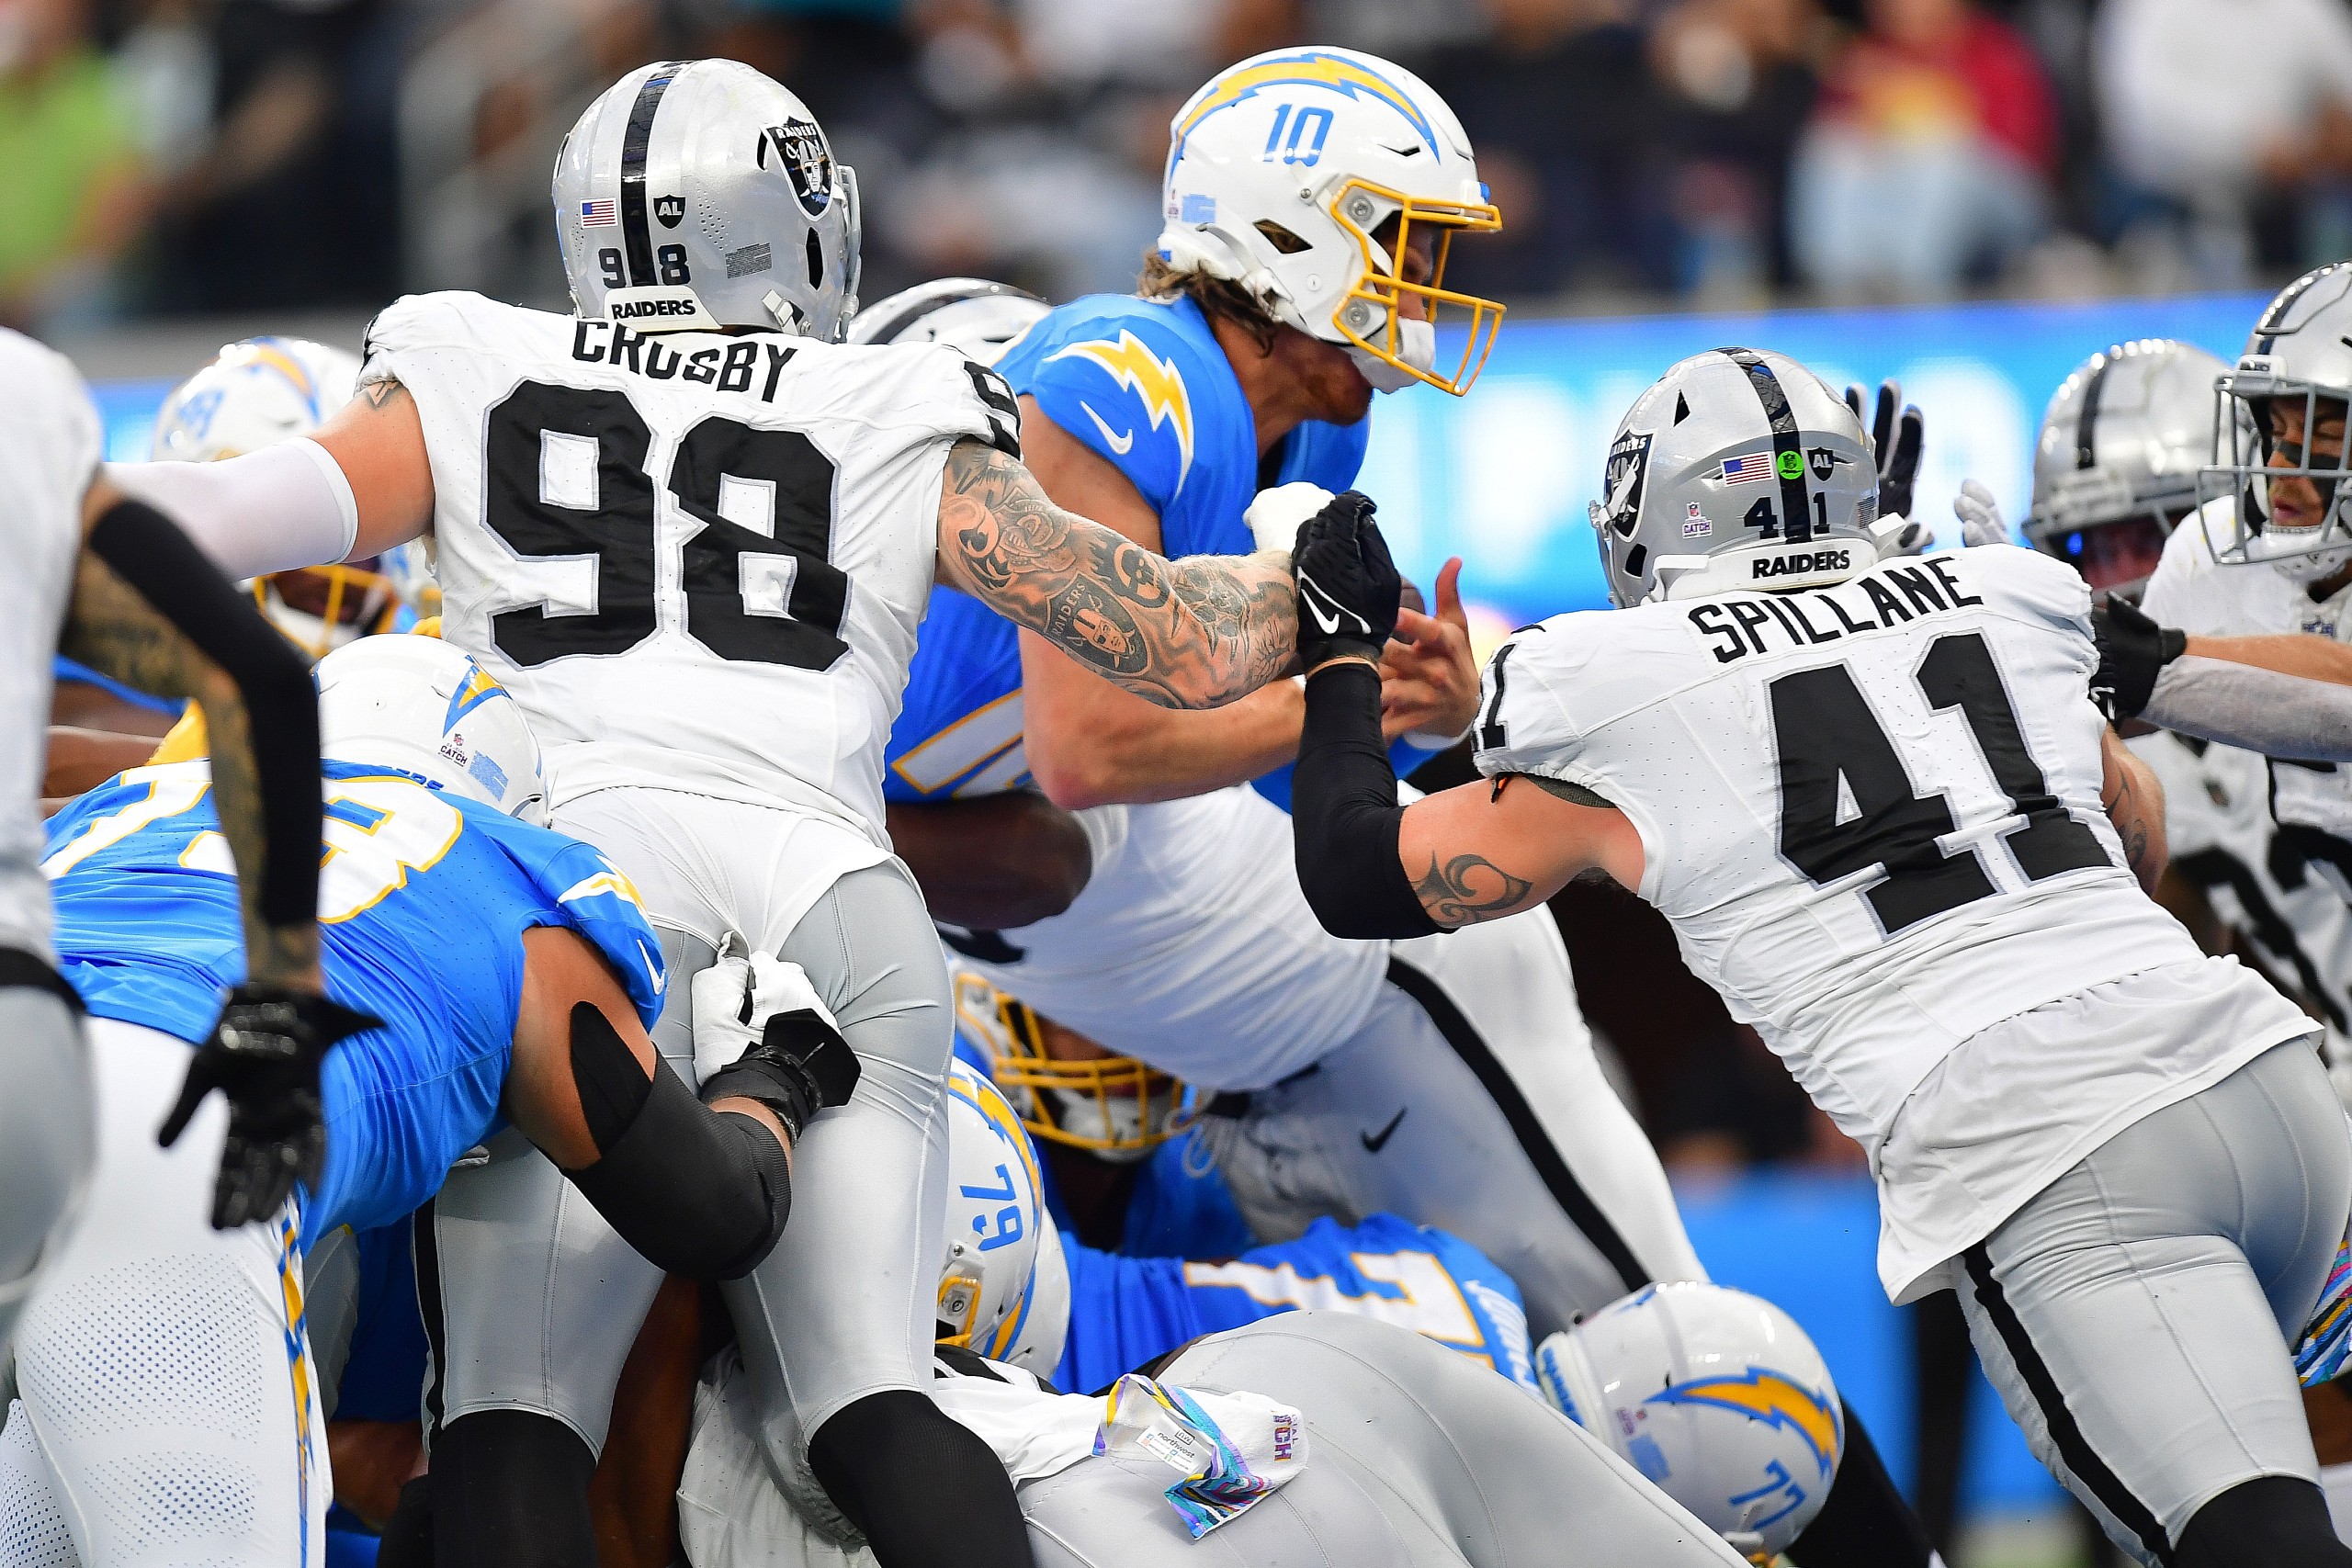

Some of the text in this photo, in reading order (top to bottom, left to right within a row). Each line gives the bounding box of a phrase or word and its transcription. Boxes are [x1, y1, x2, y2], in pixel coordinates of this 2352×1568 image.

[775, 124, 818, 139] RAIDERS
[1262, 103, 1333, 167] 10
[658, 201, 682, 216] AL
[611, 299, 695, 320] RAIDERS
[571, 321, 798, 403] CROSBY
[1611, 436, 1646, 456] AIDERS
[1813, 454, 1833, 468] AL
[480, 376, 854, 673] 98
[1752, 550, 1850, 579] RAIDERS
[1688, 556, 1983, 663] SPILLANE
[440, 745, 469, 764] CATCH
[1766, 629, 2115, 942] 41
[959, 1163, 1023, 1252] 79
[1729, 1459, 1807, 1531] 77
